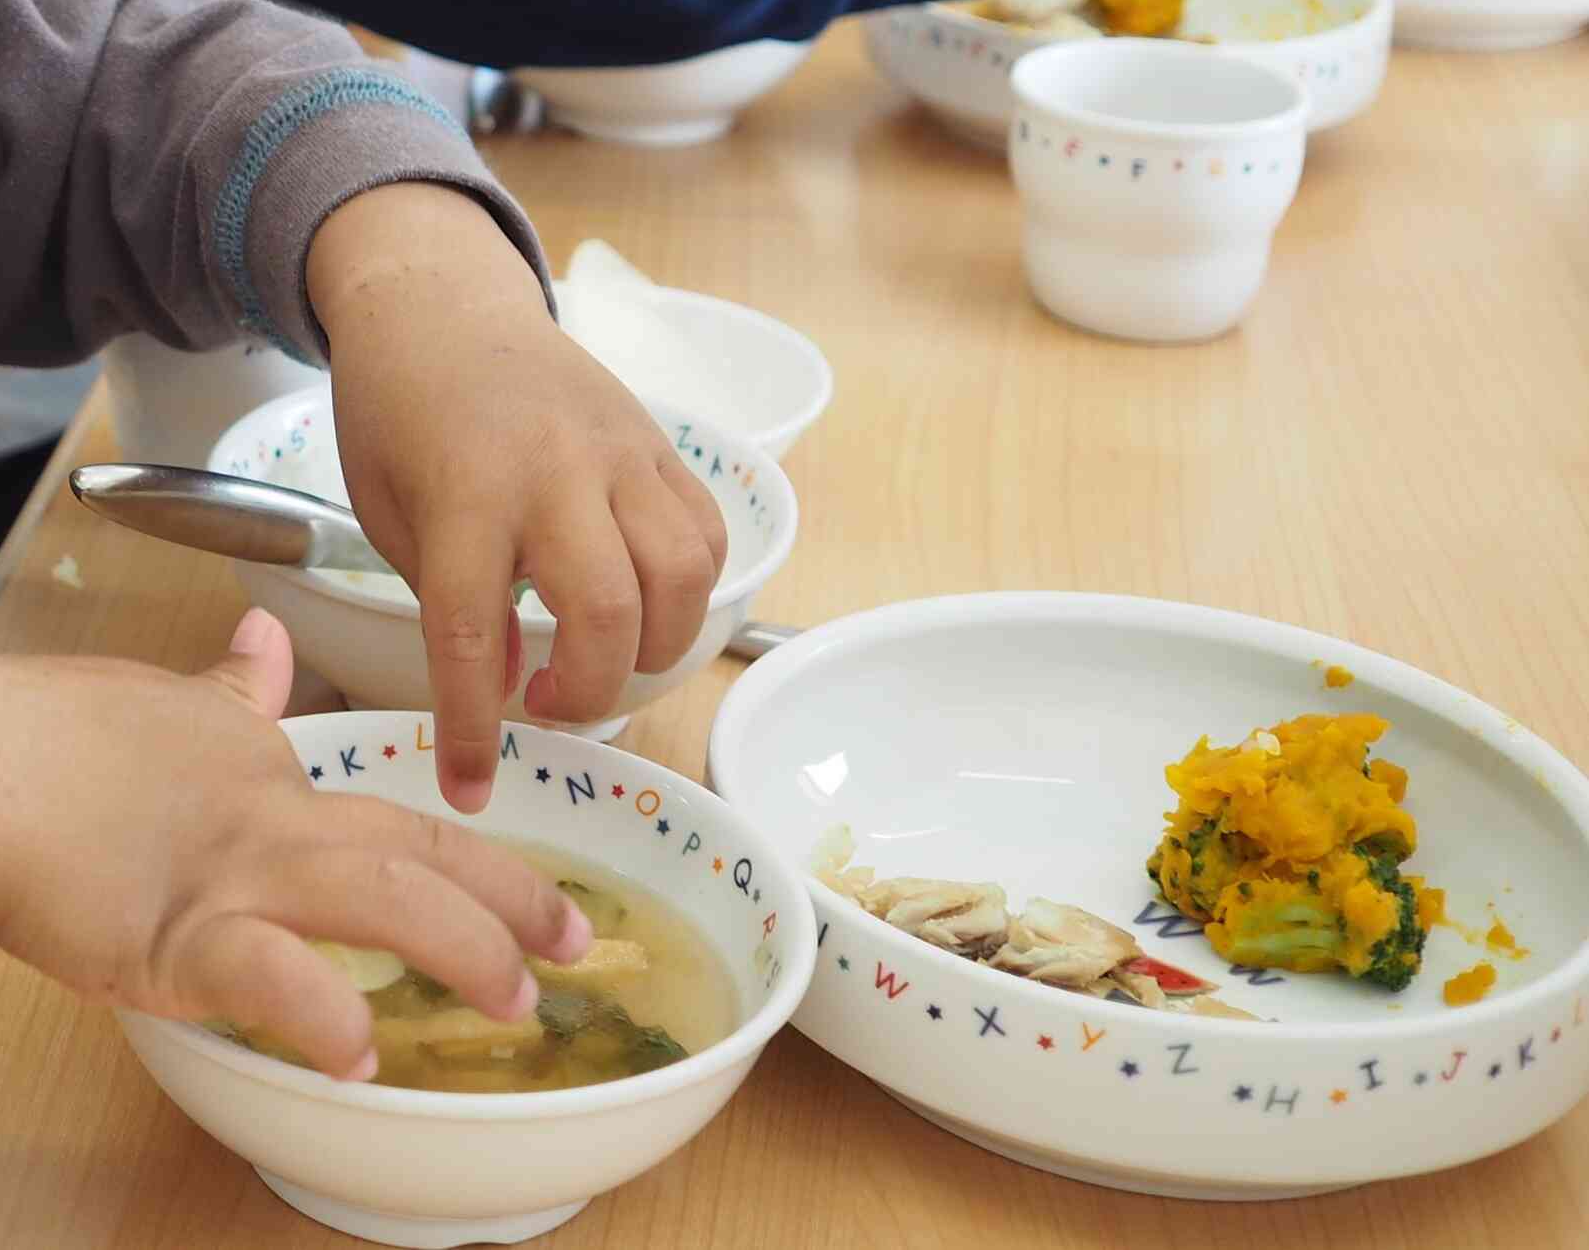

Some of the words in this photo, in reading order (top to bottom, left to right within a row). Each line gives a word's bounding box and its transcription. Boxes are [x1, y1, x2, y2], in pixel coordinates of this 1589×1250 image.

[340, 745, 365, 777] K
[416, 723, 434, 750] L
[566, 772, 596, 805] N
[635, 790, 661, 816] O
[682, 832, 701, 856] P
[733, 858, 753, 896] Q
[874, 961, 909, 999] W
[974, 1006, 1006, 1037] X
[1082, 1022, 1106, 1051] Y
[1167, 1043, 1199, 1075] Z
[1264, 1085, 1300, 1114] H
[1360, 1059, 1383, 1091] I
[1441, 1051, 1467, 1081] J
[1518, 1036, 1536, 1070] K
